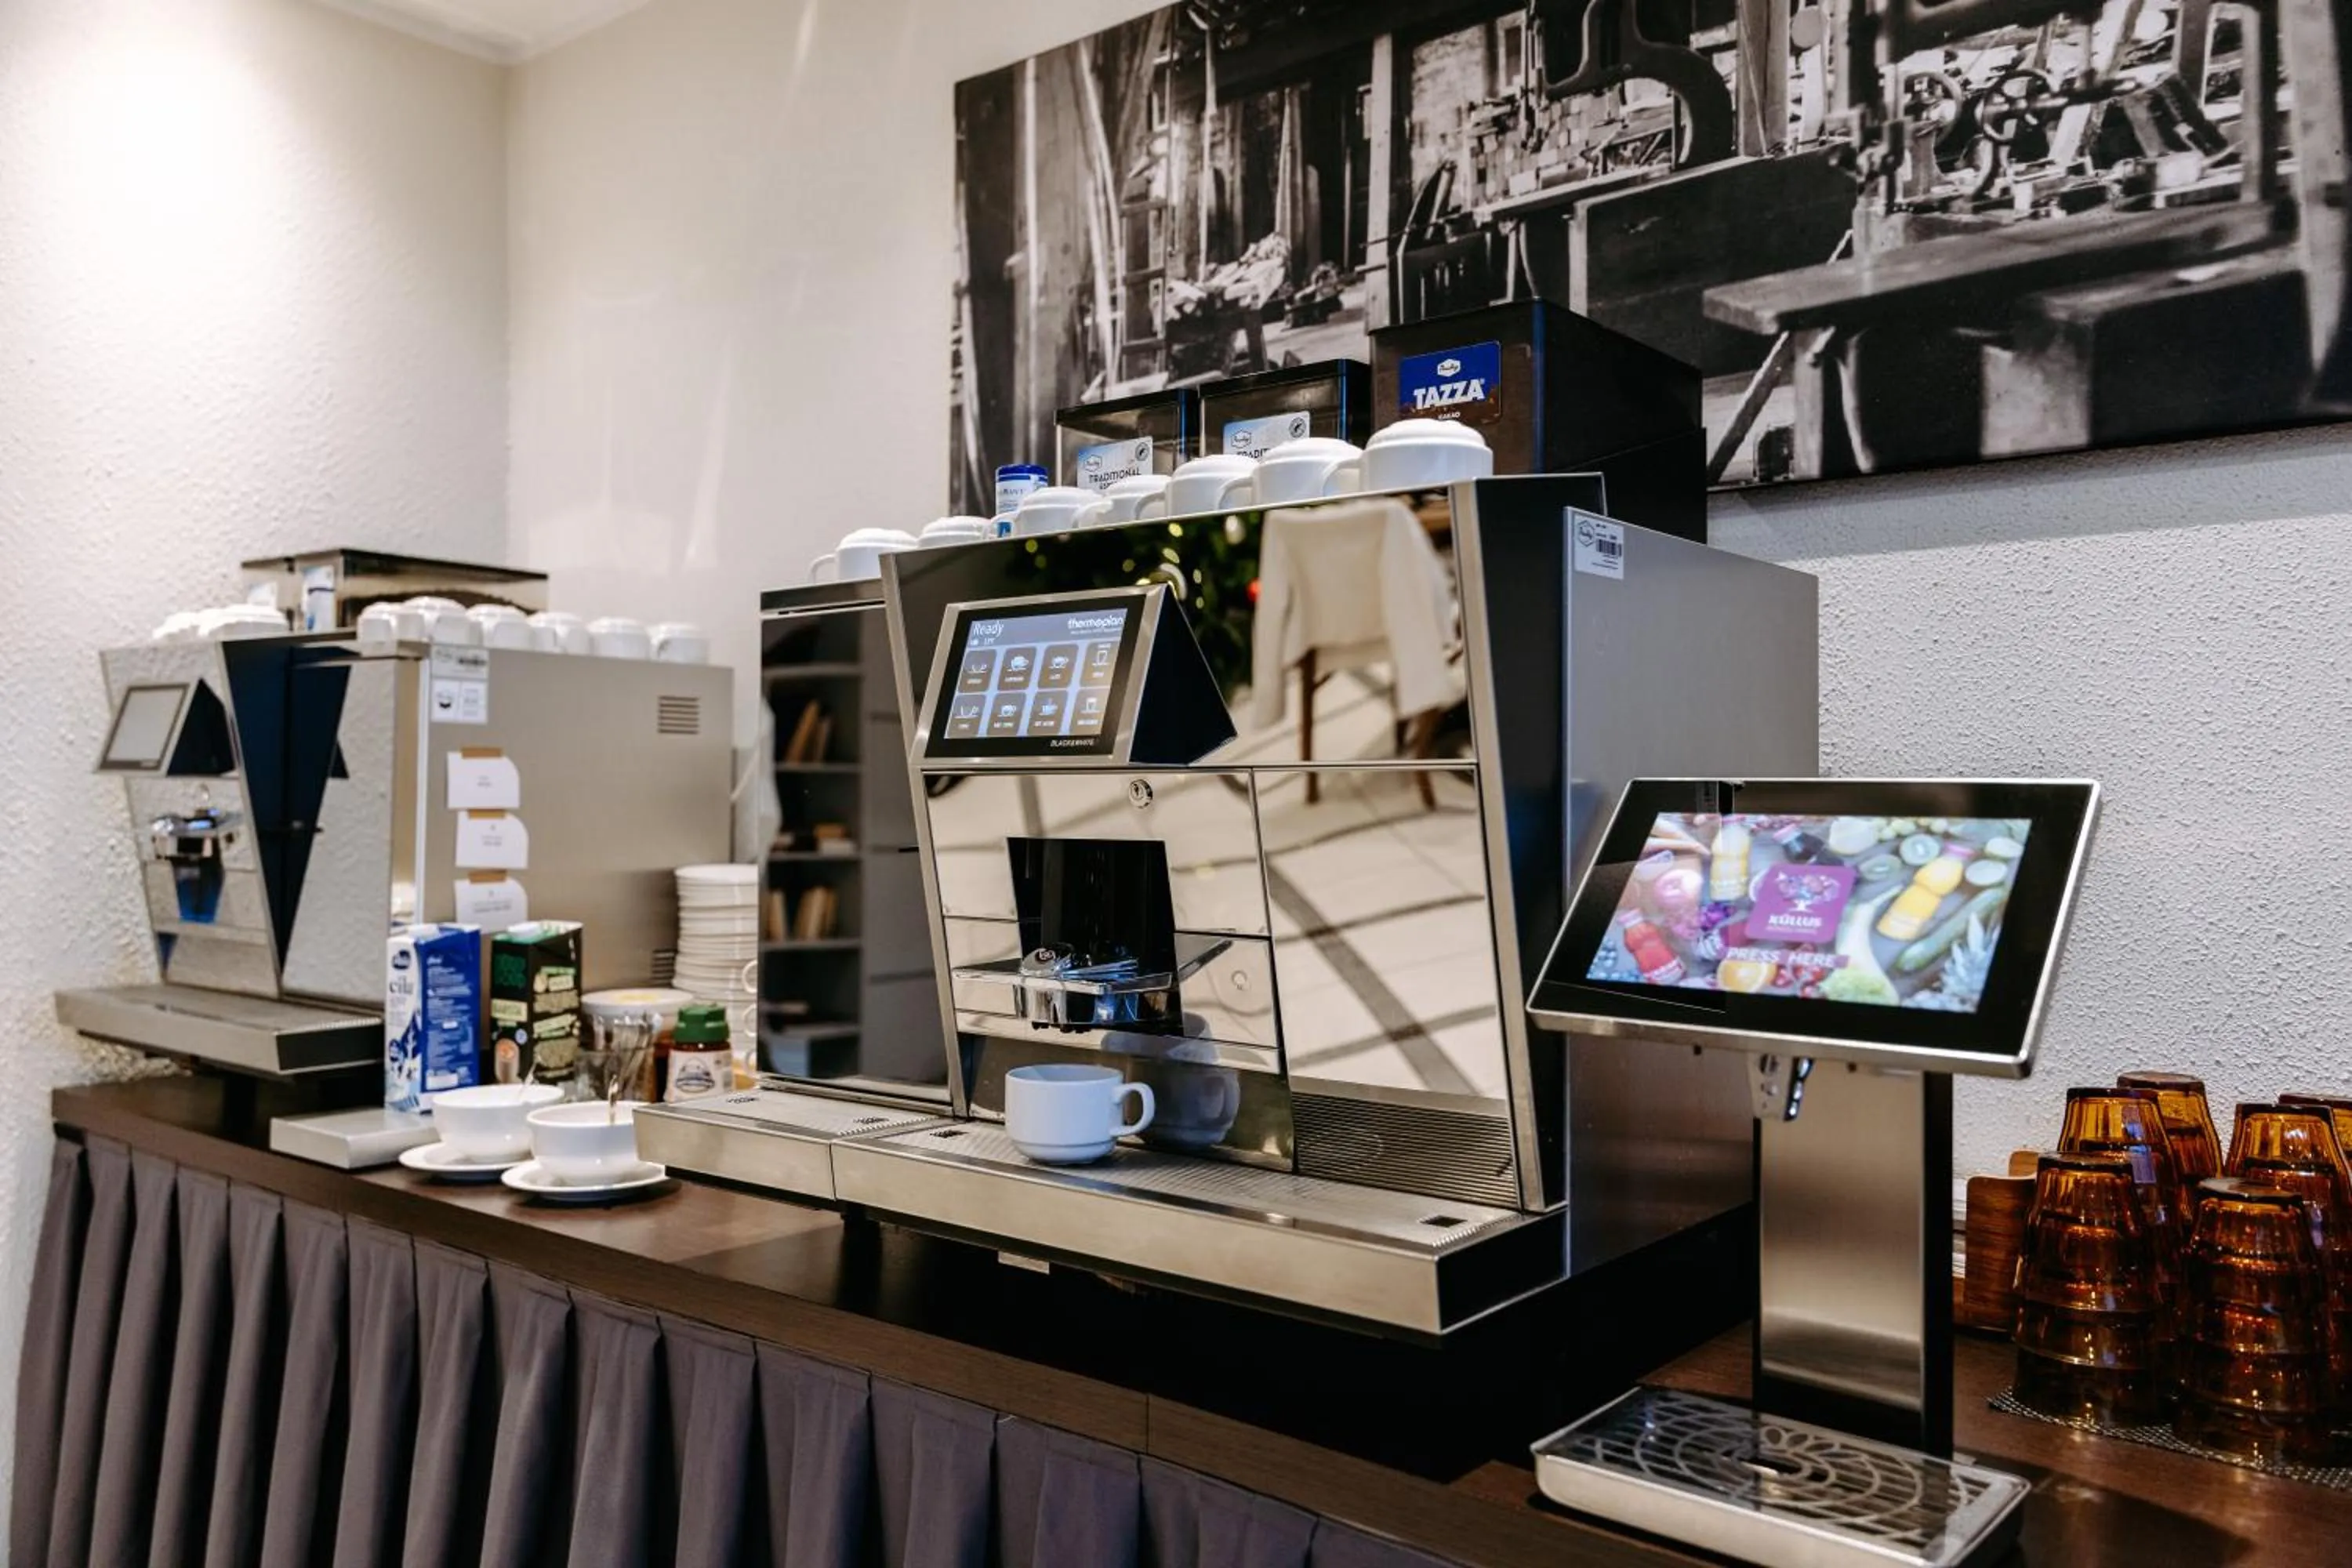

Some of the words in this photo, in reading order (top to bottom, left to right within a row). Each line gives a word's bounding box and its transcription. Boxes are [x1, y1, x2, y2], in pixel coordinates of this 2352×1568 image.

[1413, 378, 1486, 410] TAZZA
[1088, 466, 1142, 484] TRADITIONAL
[972, 620, 1004, 638] Ready
[1726, 946, 1781, 963] PRESS
[1788, 950, 1835, 968] HERE
